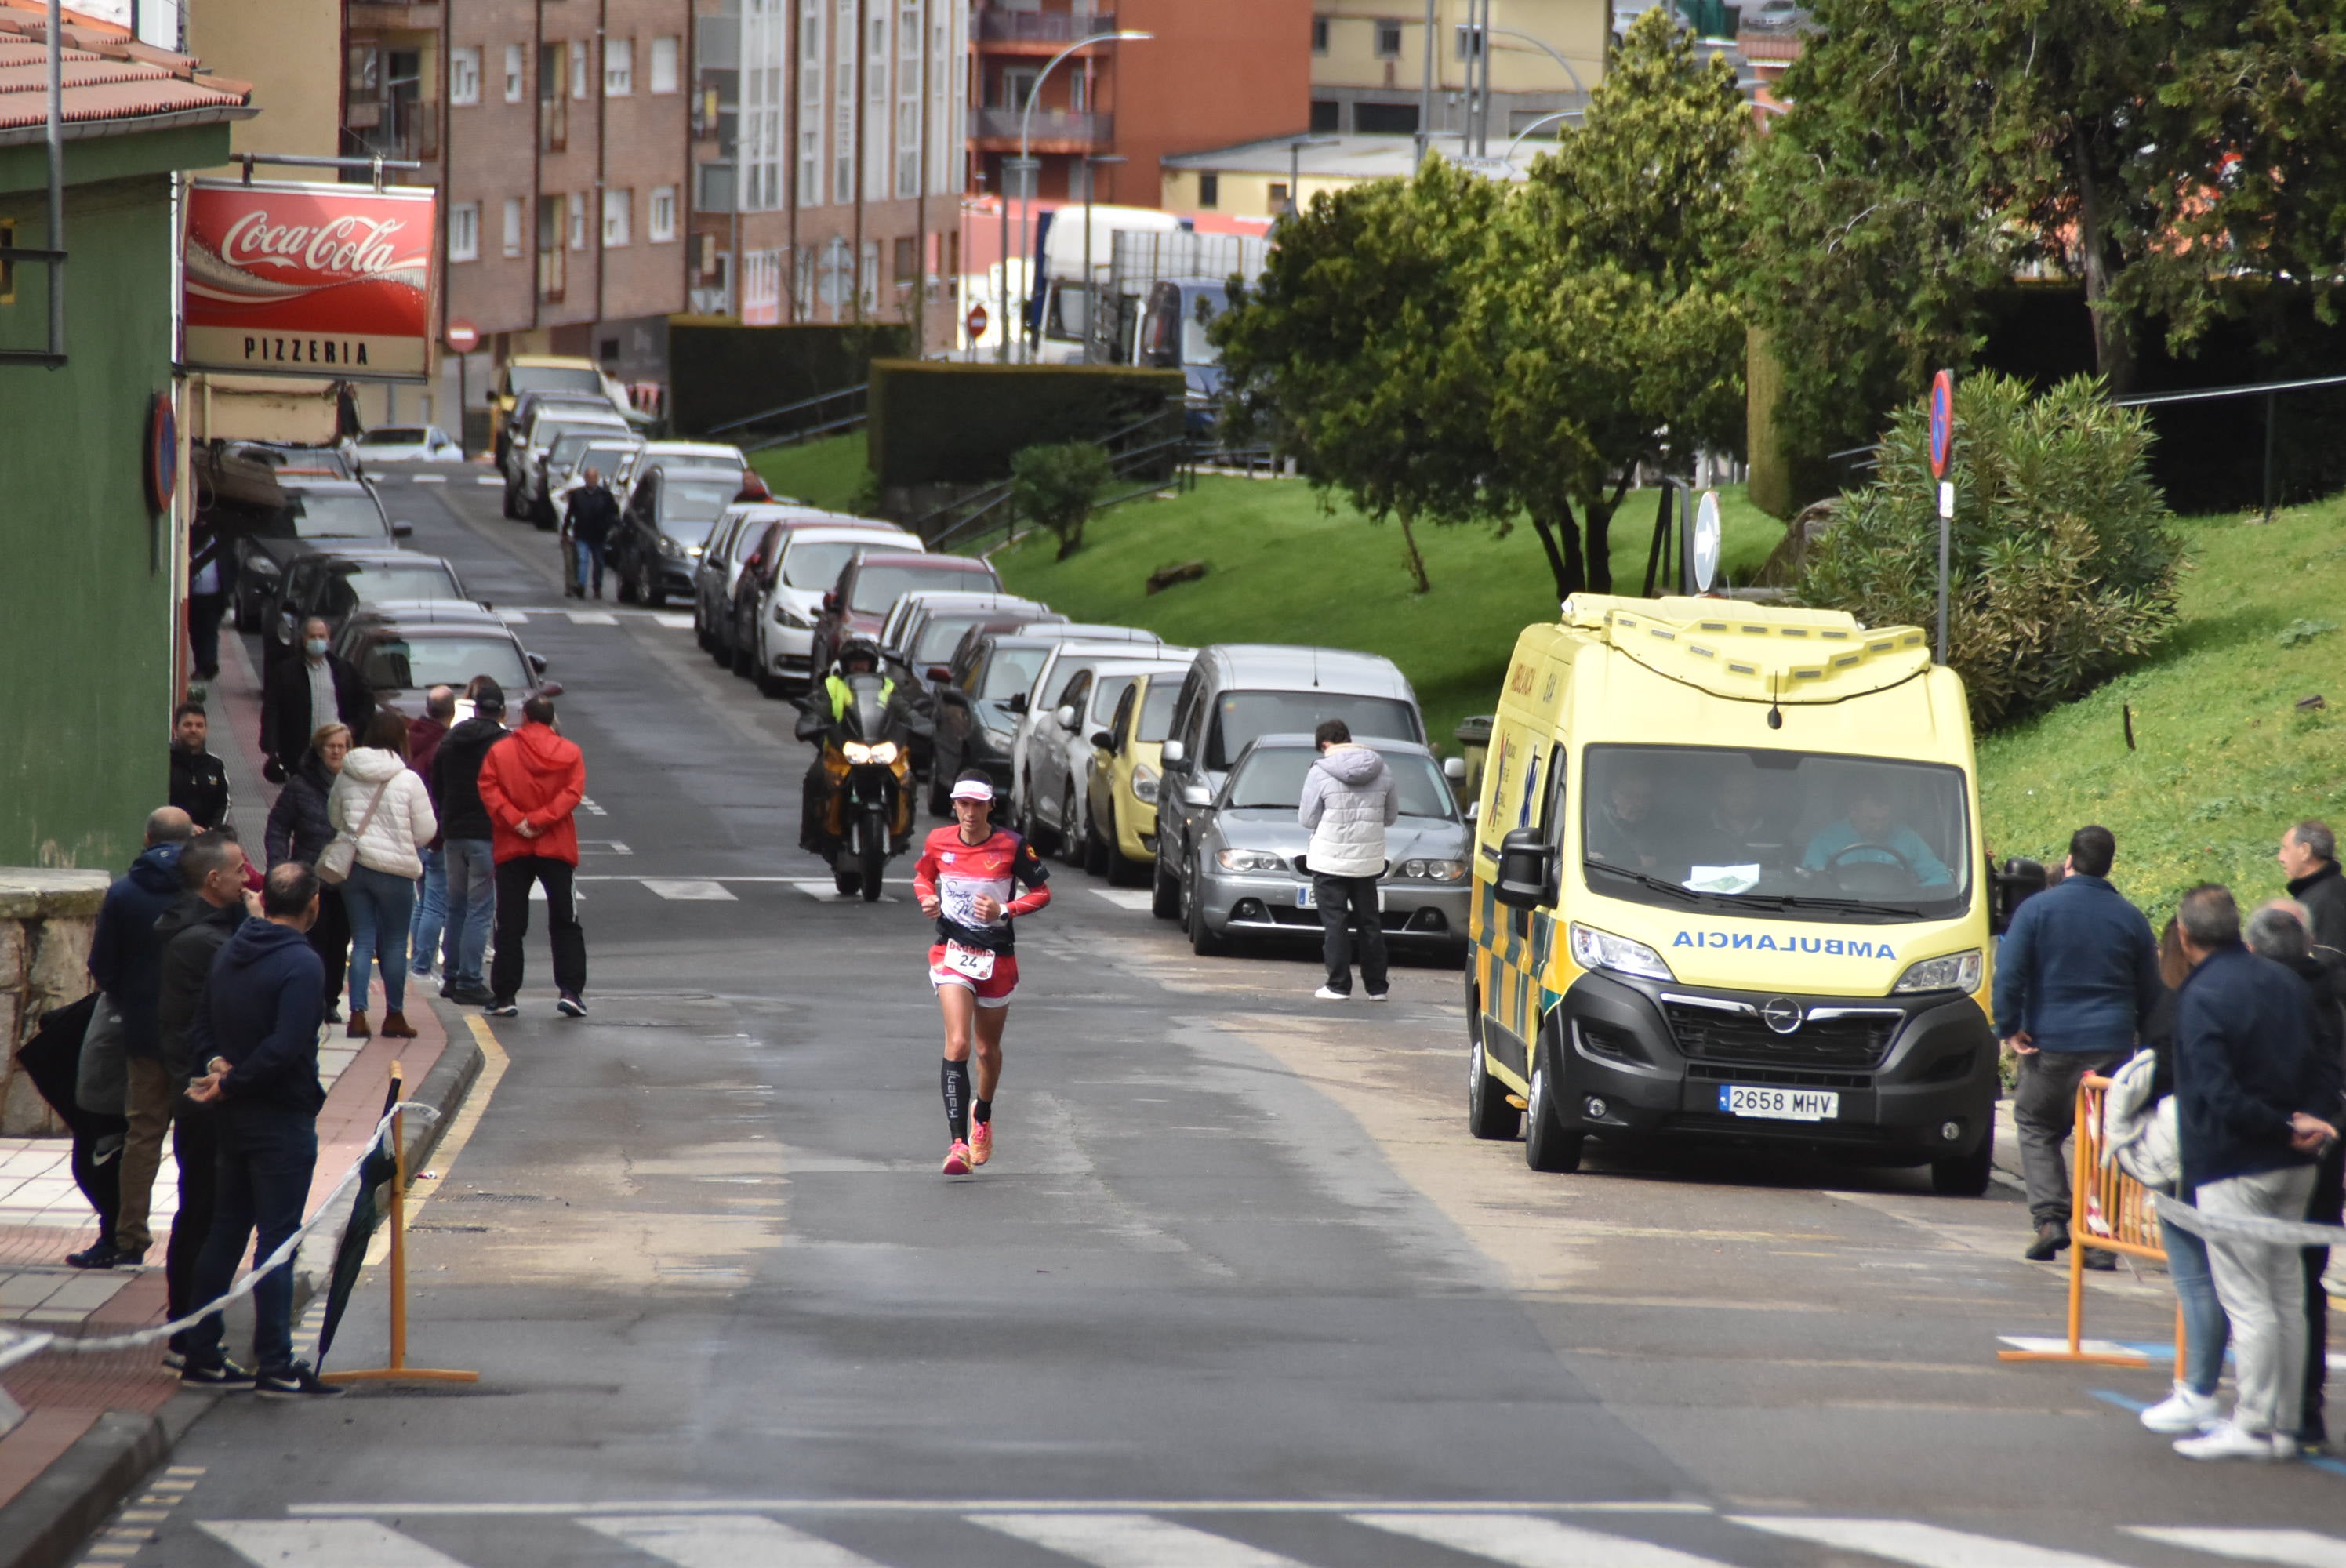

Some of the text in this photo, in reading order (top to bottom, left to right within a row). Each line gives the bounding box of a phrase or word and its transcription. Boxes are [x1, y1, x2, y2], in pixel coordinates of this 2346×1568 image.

[244, 337, 368, 366] PIZZERIA
[959, 954, 978, 968] 24
[1733, 1090, 1832, 1114] 2658 MHV
